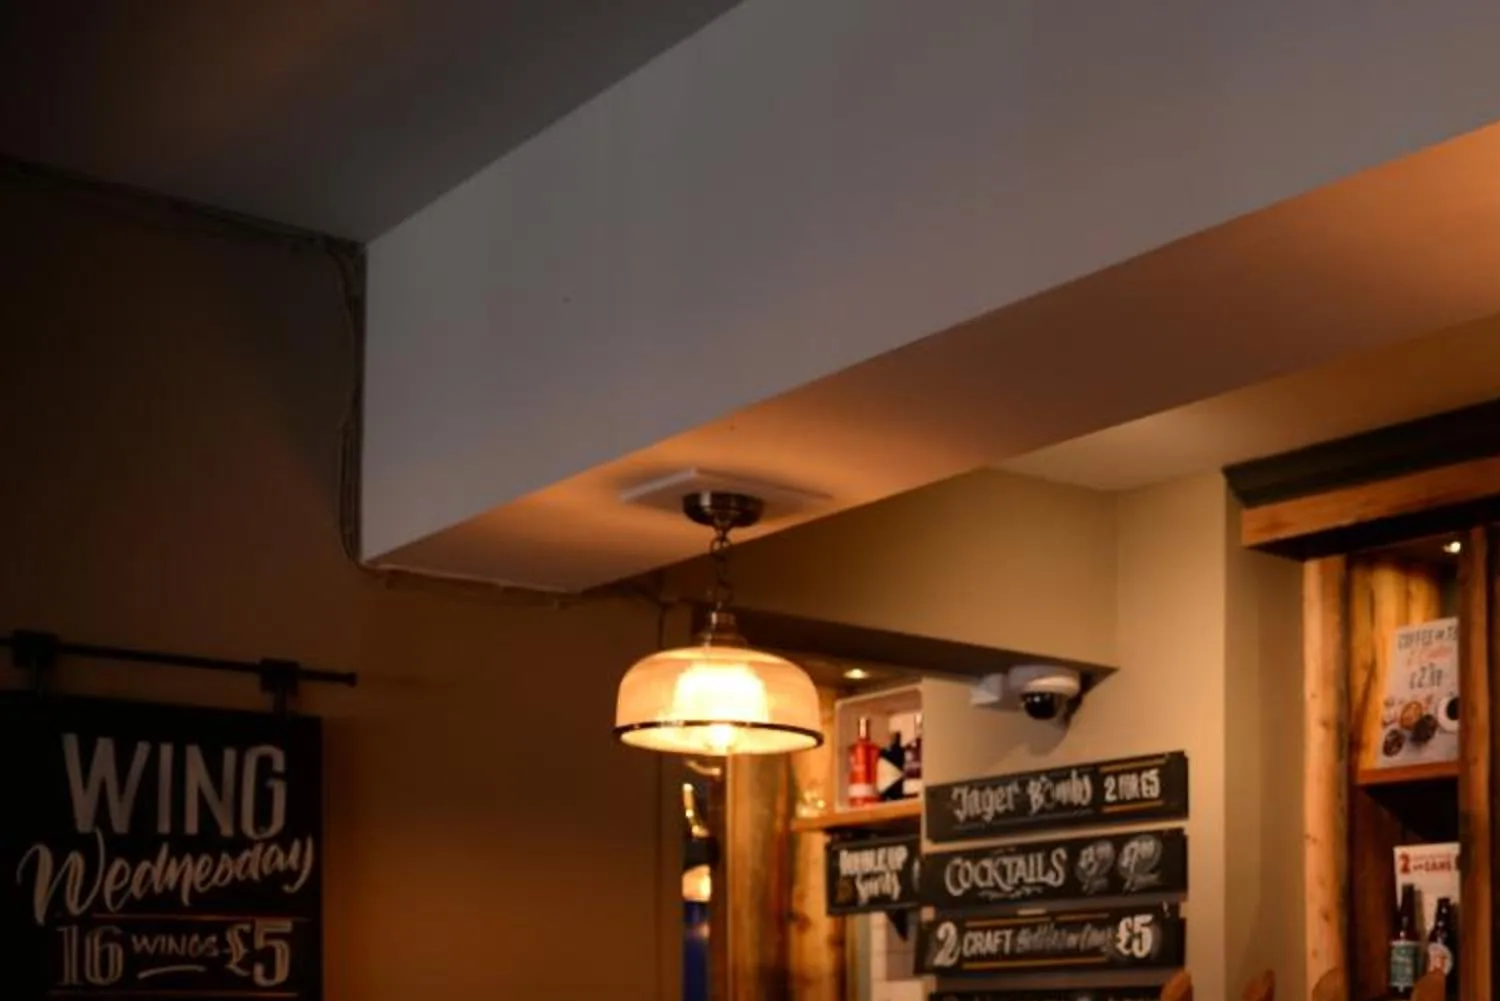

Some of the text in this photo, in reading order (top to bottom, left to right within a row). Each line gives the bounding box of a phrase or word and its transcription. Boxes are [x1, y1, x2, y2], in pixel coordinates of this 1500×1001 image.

[61, 732, 288, 840] WING
[1103, 774, 1117, 803] 2
[15, 826, 315, 928] Wednesday
[944, 846, 1069, 897] COCKTAILS
[55, 923, 125, 987] 16
[224, 918, 294, 988] £5
[933, 920, 961, 968] 2
[961, 928, 1015, 958] CRAFT
[1115, 912, 1155, 960] £5
